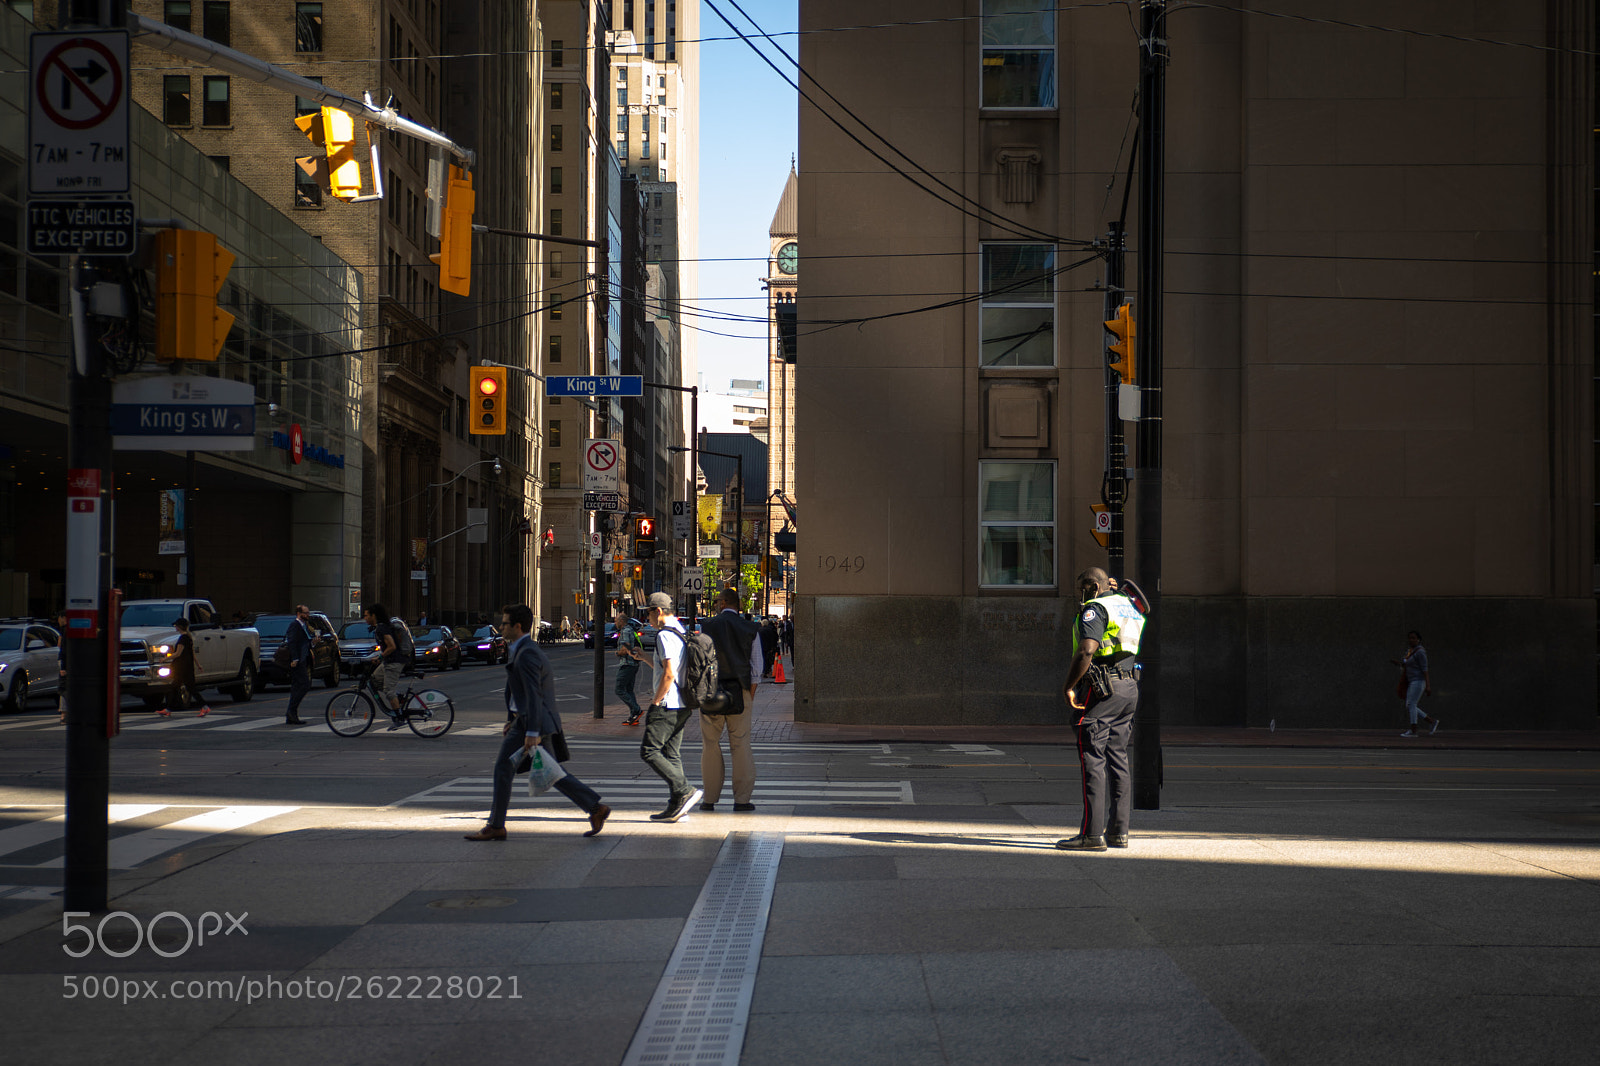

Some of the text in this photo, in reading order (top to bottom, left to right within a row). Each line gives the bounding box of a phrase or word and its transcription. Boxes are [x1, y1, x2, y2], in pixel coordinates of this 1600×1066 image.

[87, 176, 102, 187] FRI
[30, 208, 132, 225] TTC VEHICLES
[34, 229, 127, 247] EXCEPTED
[567, 378, 621, 395] King St W
[140, 407, 228, 433] King St W
[818, 555, 865, 573] 1949
[683, 578, 702, 590] 40
